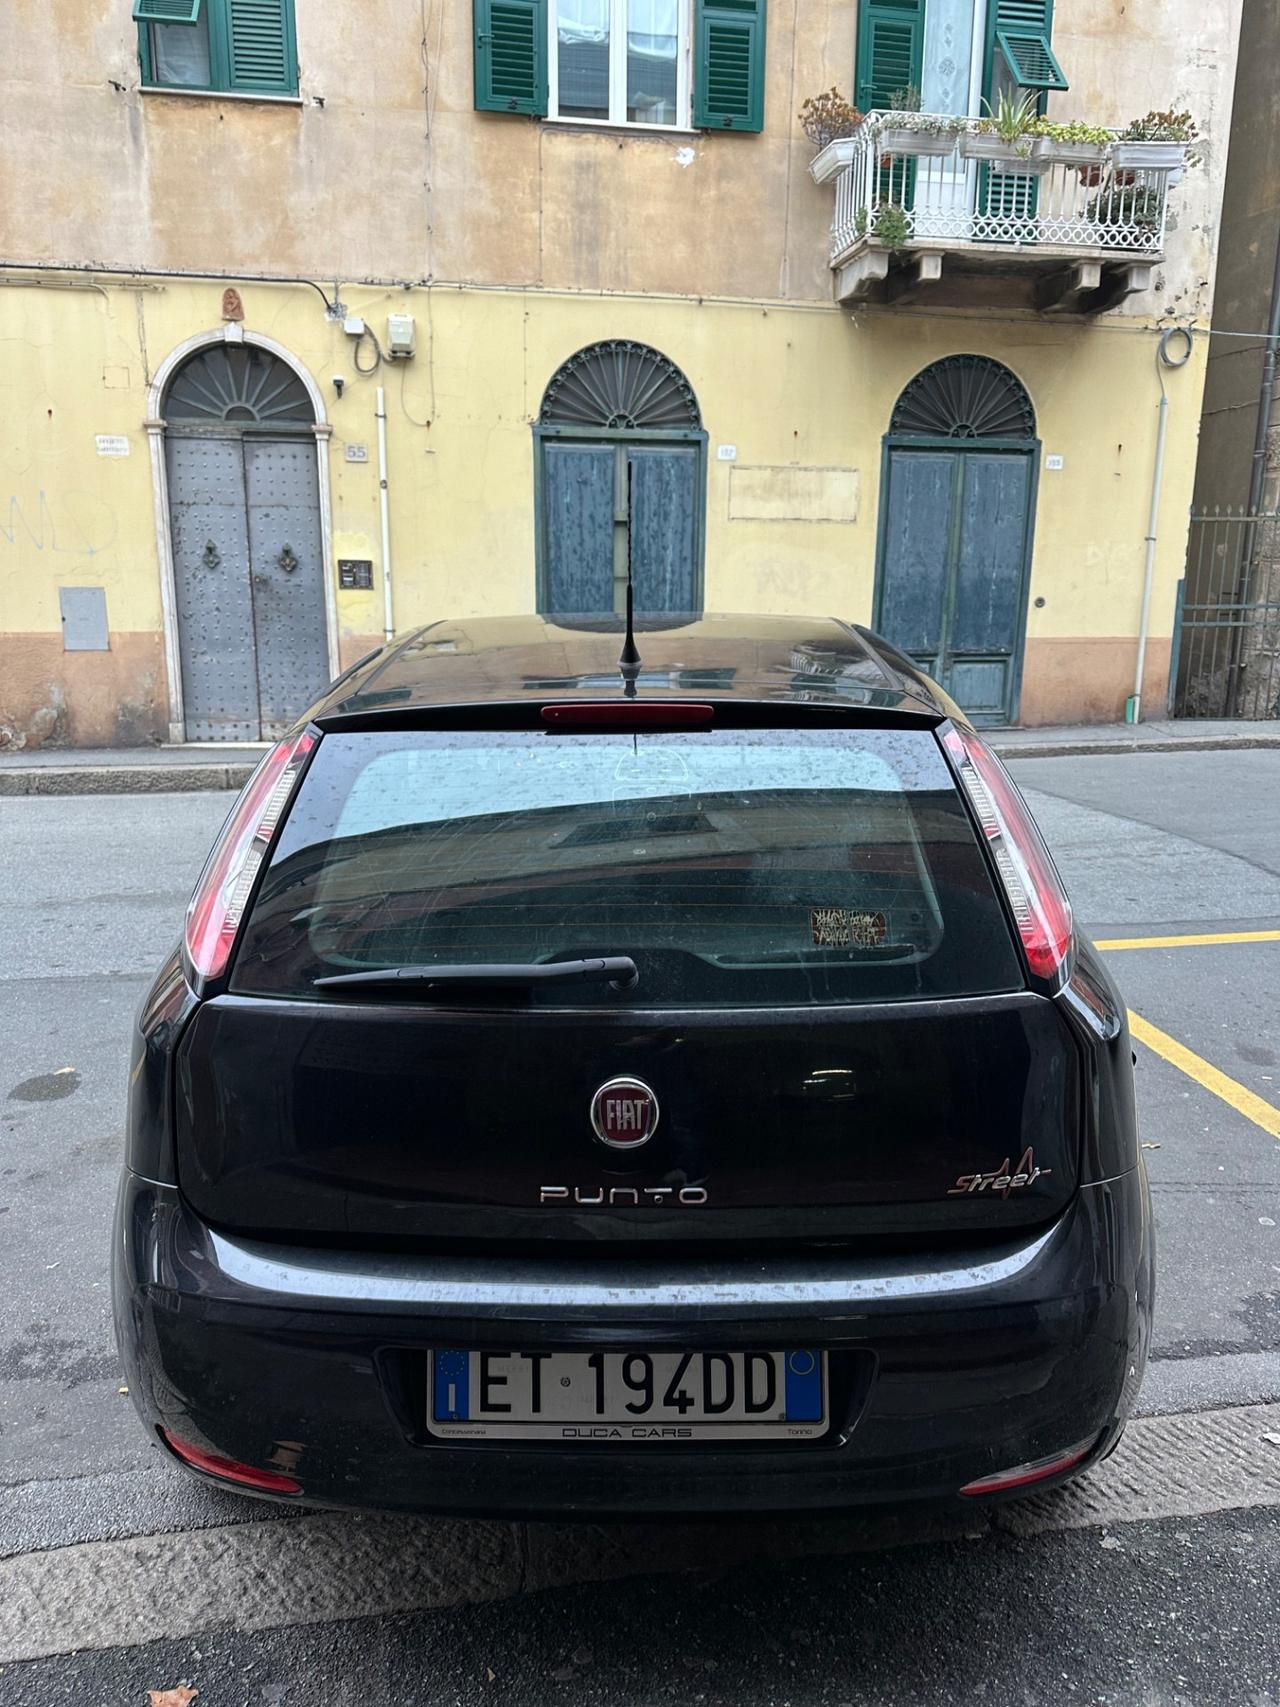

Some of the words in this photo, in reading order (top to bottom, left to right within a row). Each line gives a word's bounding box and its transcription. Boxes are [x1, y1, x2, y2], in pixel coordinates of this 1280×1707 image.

[347, 445, 366, 458] 55
[606, 1099, 645, 1131] FIAT
[946, 1157, 1050, 1197] Street
[539, 1186, 708, 1204] PUNTO
[480, 1351, 552, 1413] ET
[588, 1351, 776, 1414] 194DD
[562, 1428, 622, 1437] DUCA
[631, 1428, 692, 1437] CARS
